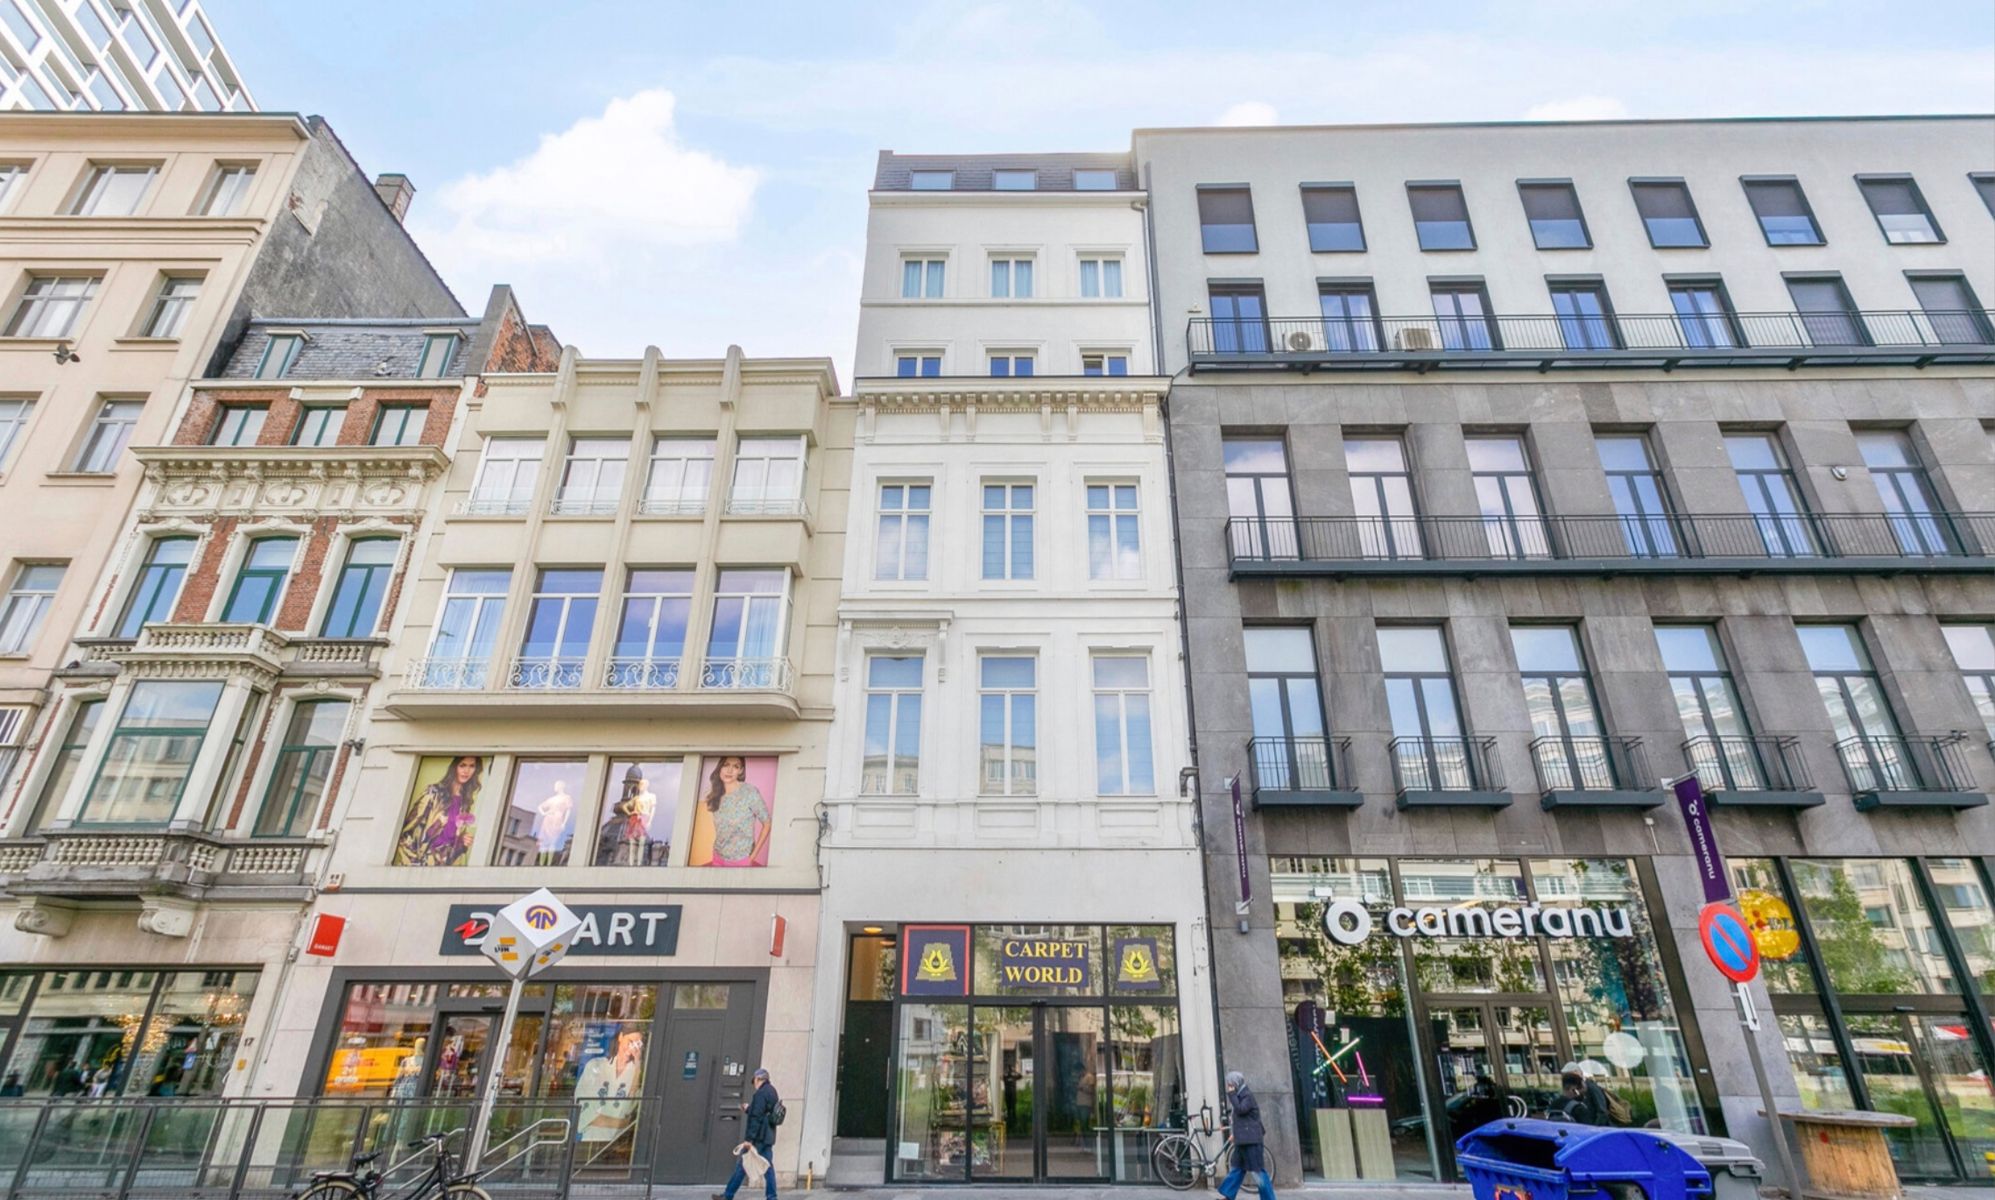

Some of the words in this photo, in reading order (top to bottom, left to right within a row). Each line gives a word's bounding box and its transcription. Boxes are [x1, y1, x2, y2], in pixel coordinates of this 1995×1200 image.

[1693, 818, 1716, 879] cameranu
[463, 912, 668, 946] DART
[1387, 906, 1633, 937] cameranu
[1005, 941, 1087, 958] CARPET
[1004, 966, 1083, 984] WORLD
[244, 1037, 255, 1047] 17
